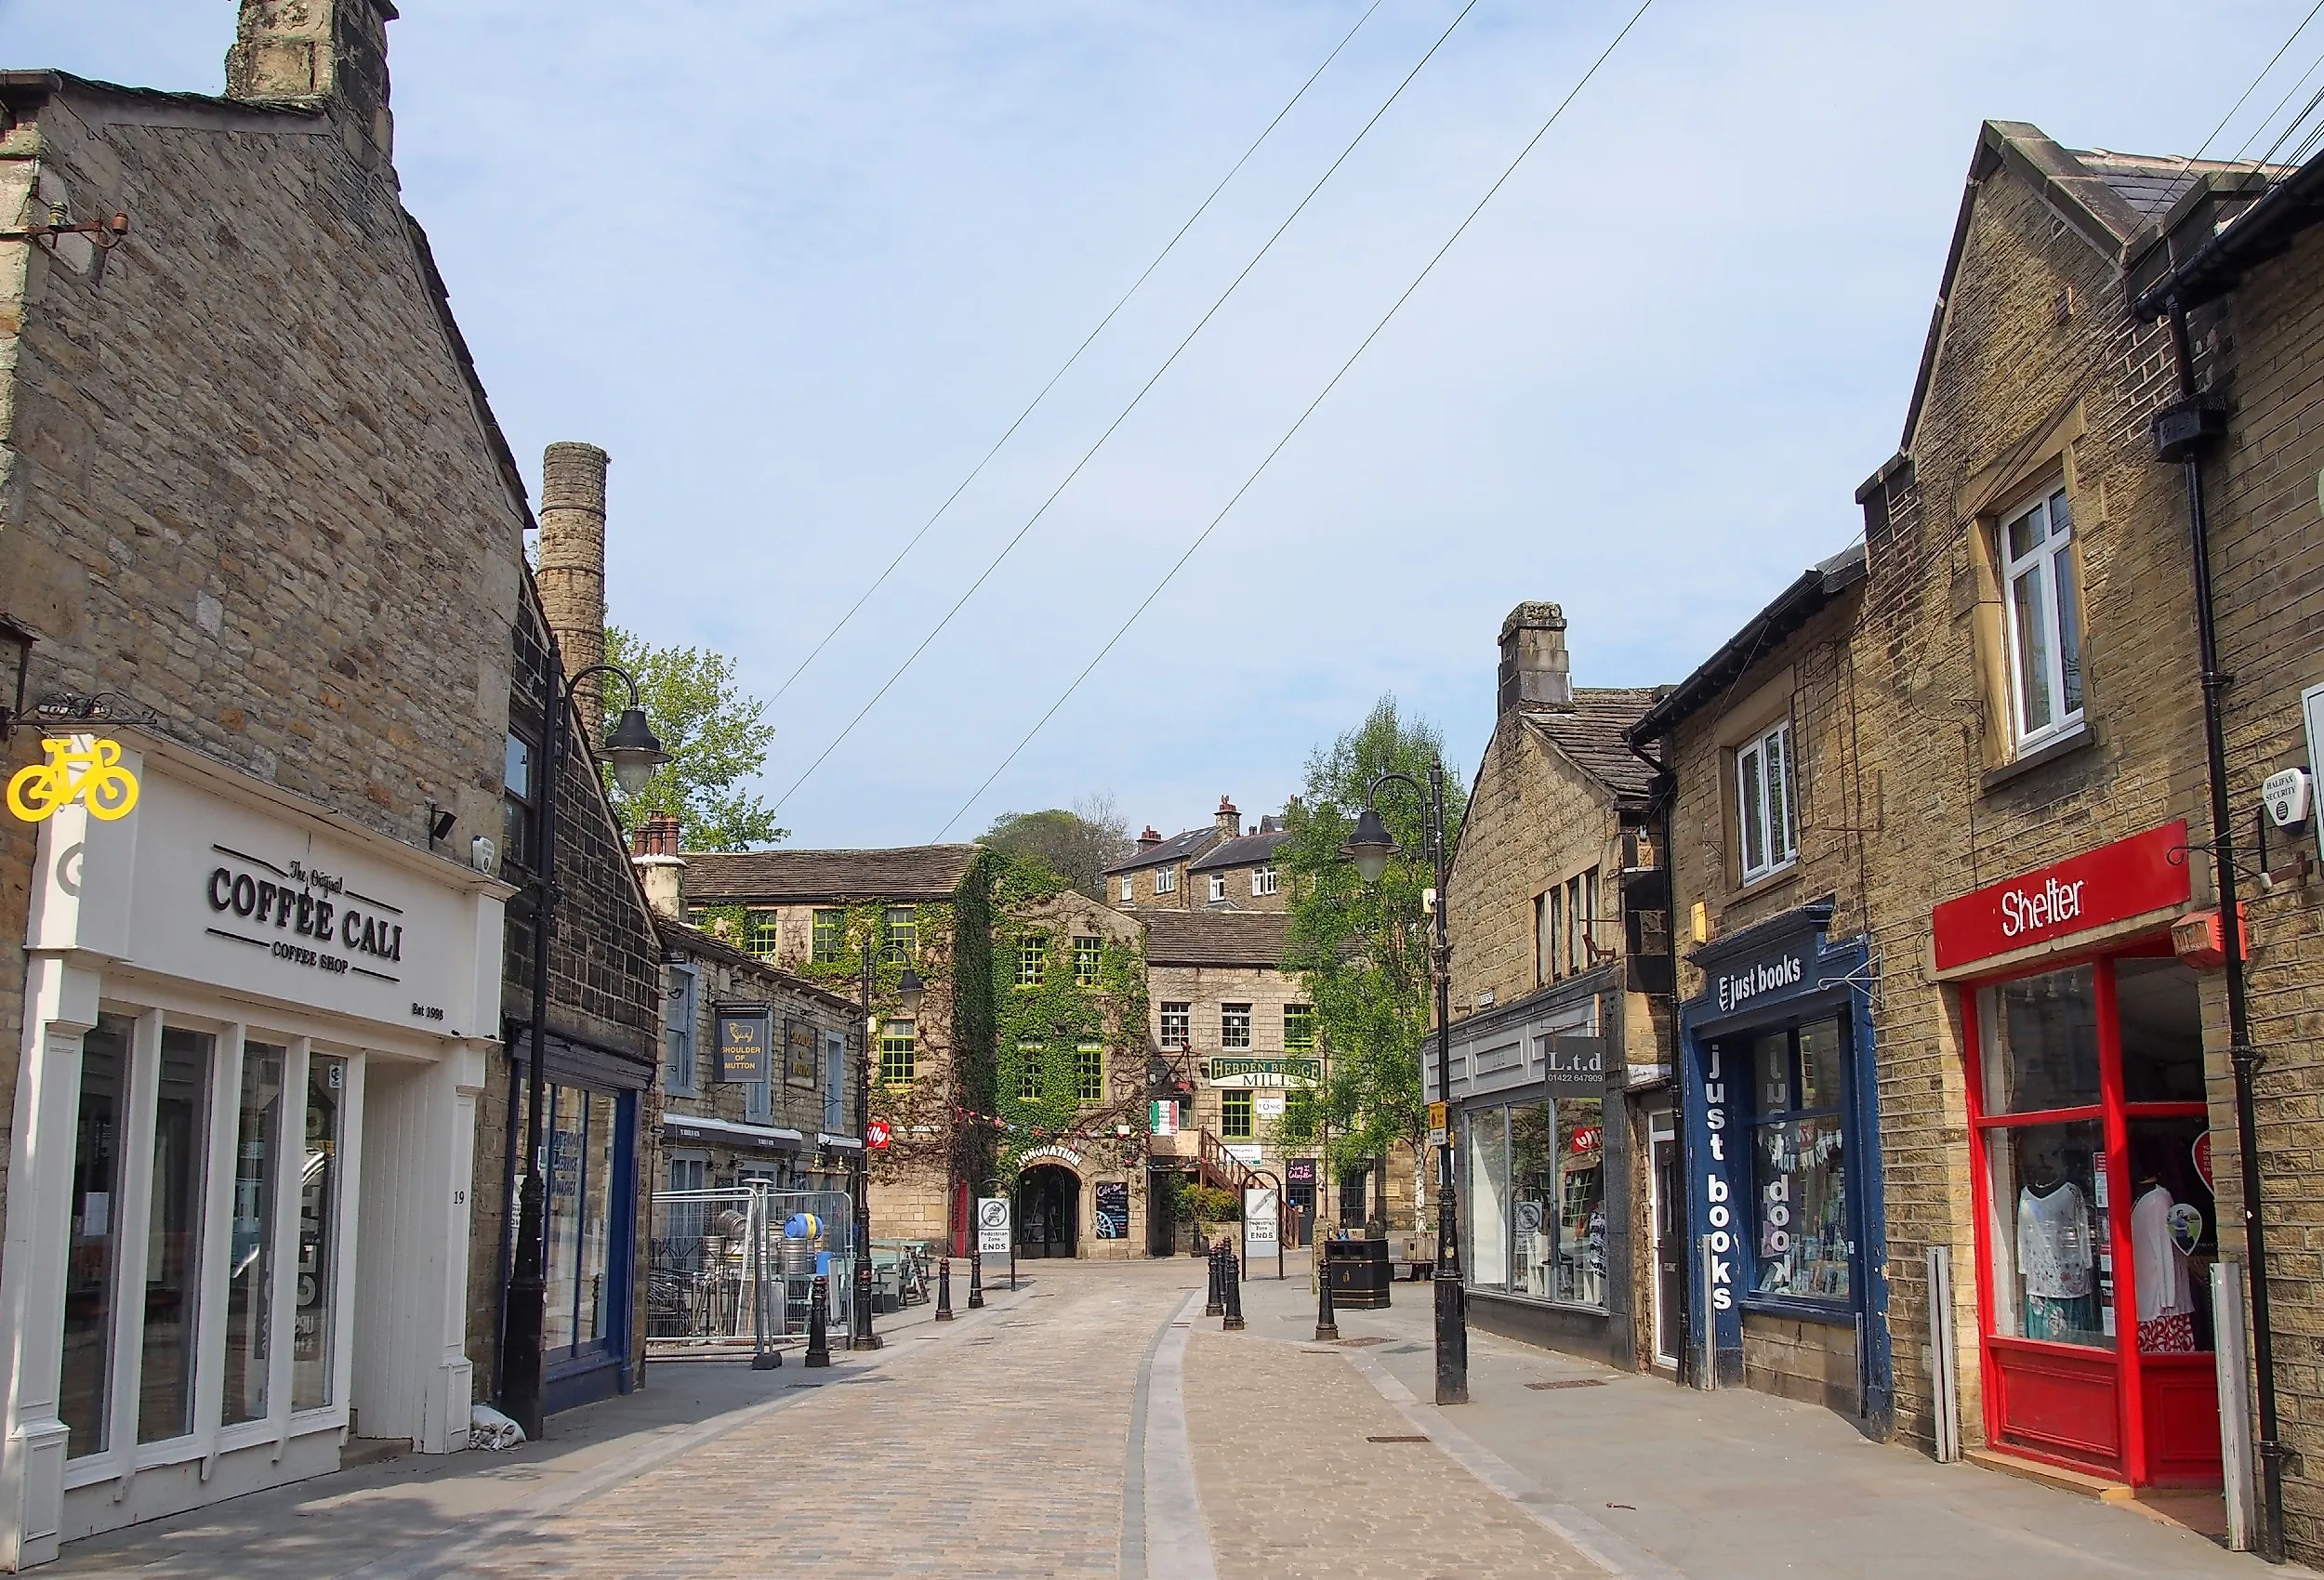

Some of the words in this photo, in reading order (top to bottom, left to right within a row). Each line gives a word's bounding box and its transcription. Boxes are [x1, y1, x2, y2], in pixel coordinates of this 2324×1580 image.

[2266, 774, 2294, 790] HALIFAX
[2265, 785, 2296, 802] SECURITY
[290, 861, 307, 882] The
[310, 869, 343, 898] Original
[211, 868, 334, 941] COFFEE
[341, 909, 403, 962] CALI
[2001, 876, 2085, 937] Shelter
[272, 941, 317, 968] COFFEE
[320, 953, 349, 975] SHOP
[1730, 968, 1755, 1011] just
[1757, 954, 1801, 994] books
[412, 1002, 425, 1017] Est
[426, 1006, 444, 1021] 1998
[721, 1046, 761, 1054] SHOULDER
[723, 1061, 756, 1070] MUTTON
[1213, 1060, 1267, 1078] HEBDEN
[1548, 1051, 1602, 1072] L.t.d
[1574, 1074, 1604, 1083] 647909
[1258, 1102, 1282, 1111] TONIC
[1705, 1044, 1726, 1162] just
[866, 1126, 887, 1146] illy
[1015, 1144, 1082, 1167] INNOVATION
[454, 1191, 465, 1205] 19
[1707, 1174, 1732, 1310] books
